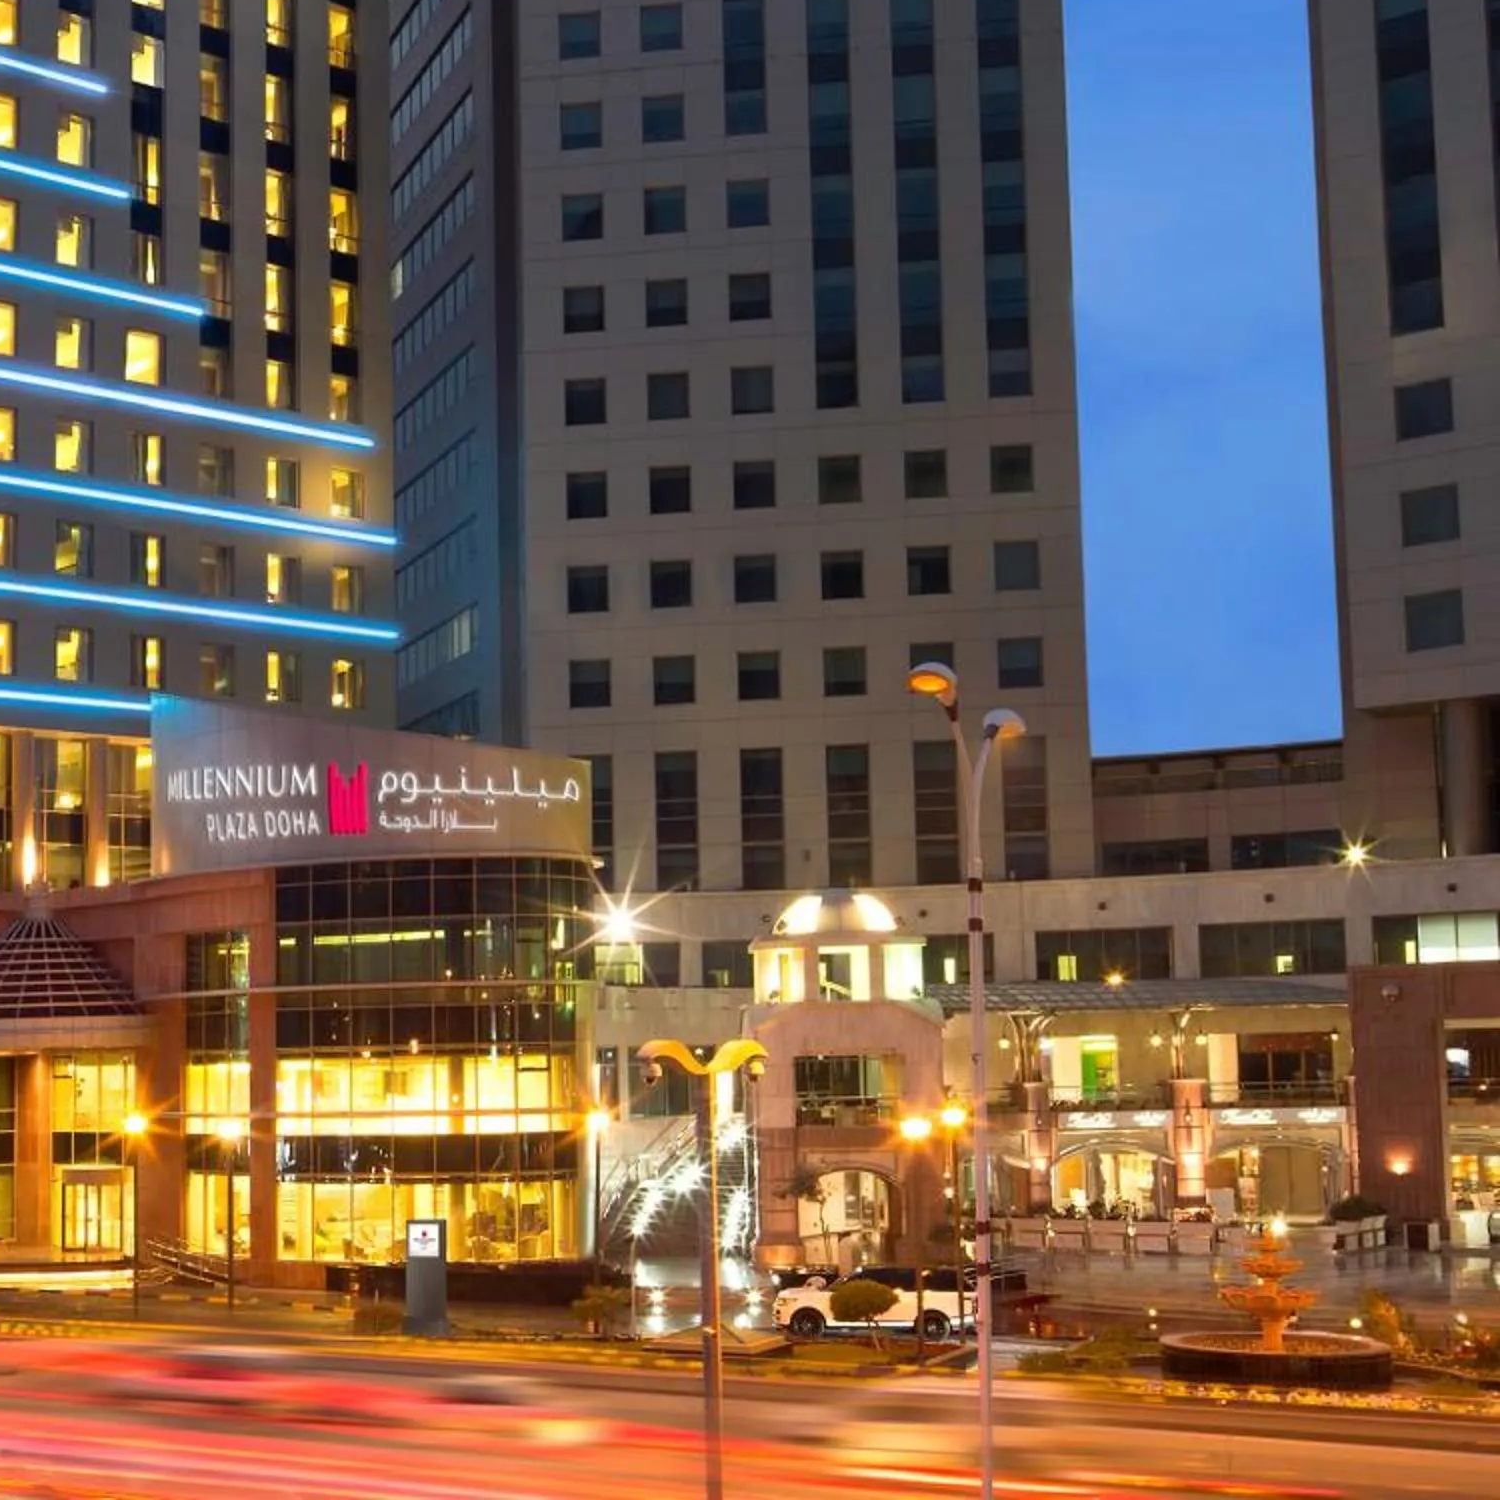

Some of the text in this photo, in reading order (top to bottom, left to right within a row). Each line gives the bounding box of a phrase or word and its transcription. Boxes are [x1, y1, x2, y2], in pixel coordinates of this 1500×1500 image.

[167, 763, 318, 803] MILLENNIUM
[377, 765, 581, 808] ميلينيوم
[207, 810, 321, 842] PLAZA DOHA
